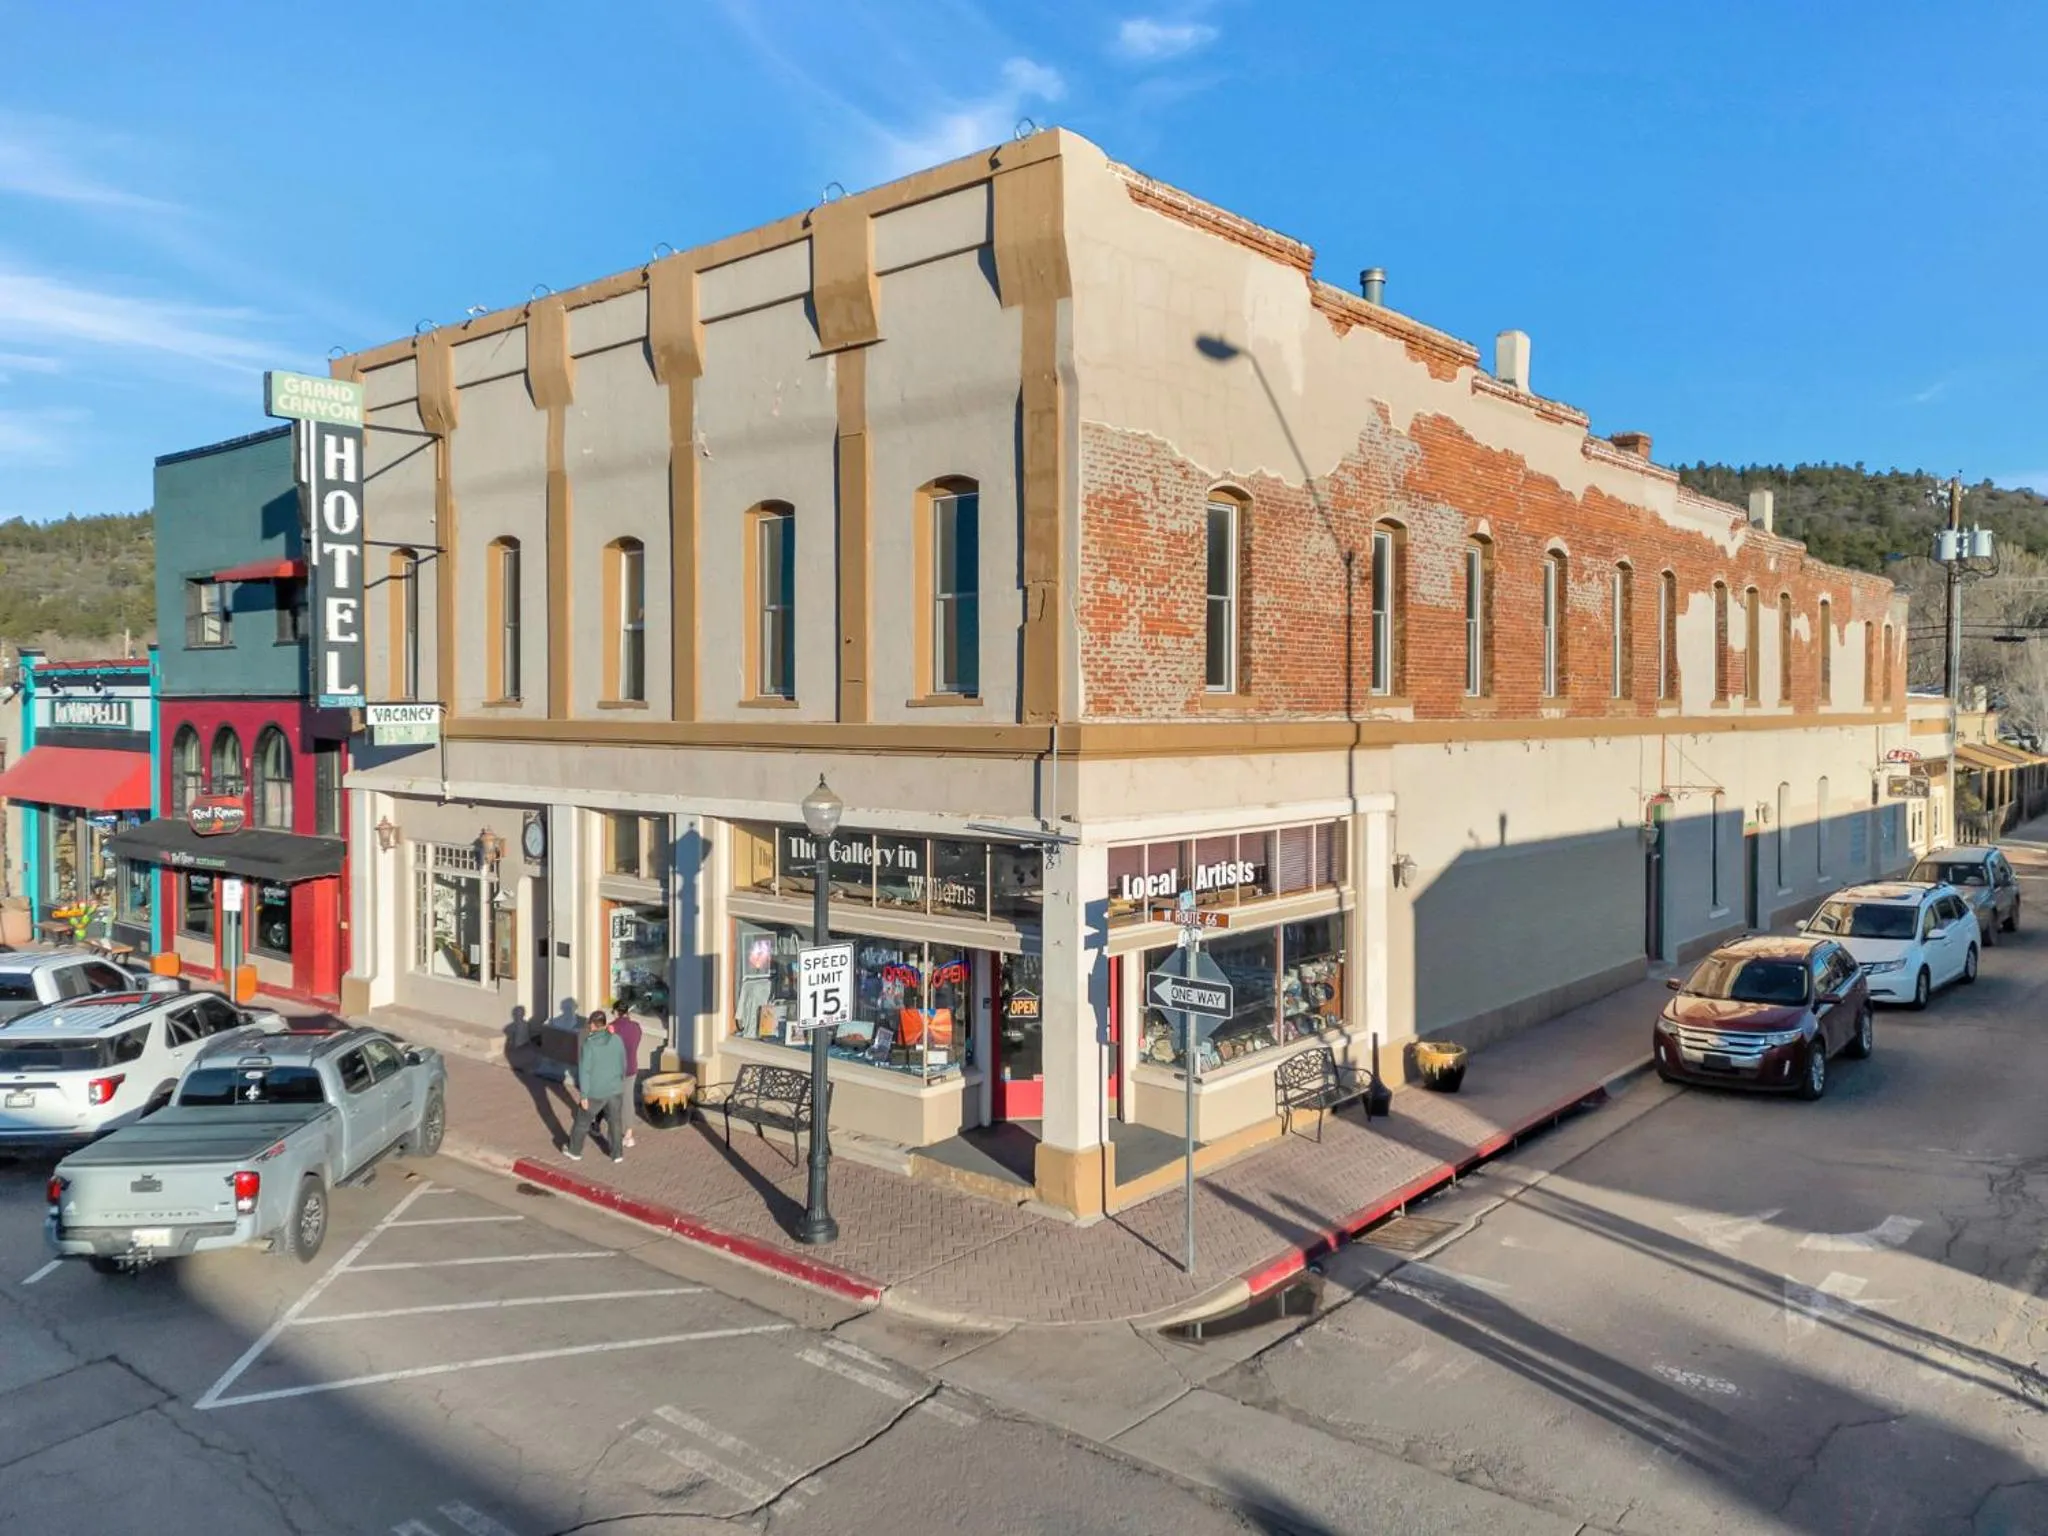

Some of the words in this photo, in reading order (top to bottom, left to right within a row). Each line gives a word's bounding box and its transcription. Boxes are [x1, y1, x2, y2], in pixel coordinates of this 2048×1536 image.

[284, 378, 353, 403] GRAND
[278, 394, 358, 422] CANYON
[323, 433, 359, 695] HOTEL
[372, 707, 434, 722] VACANCY
[192, 806, 212, 820] Red
[214, 806, 244, 819] Raven
[829, 839, 895, 867] Gallery
[898, 844, 917, 869] in
[1123, 868, 1177, 900] Local
[1195, 861, 1255, 890] Artists
[1175, 910, 1201, 925] ROUTE
[1205, 912, 1218, 927] 66
[803, 954, 848, 971] SPEED
[808, 971, 843, 986] LIMIT
[810, 988, 841, 1018] 15
[1171, 986, 1193, 1002] ONE
[1197, 990, 1222, 1006] WAY
[1010, 1000, 1038, 1015] OPEN
